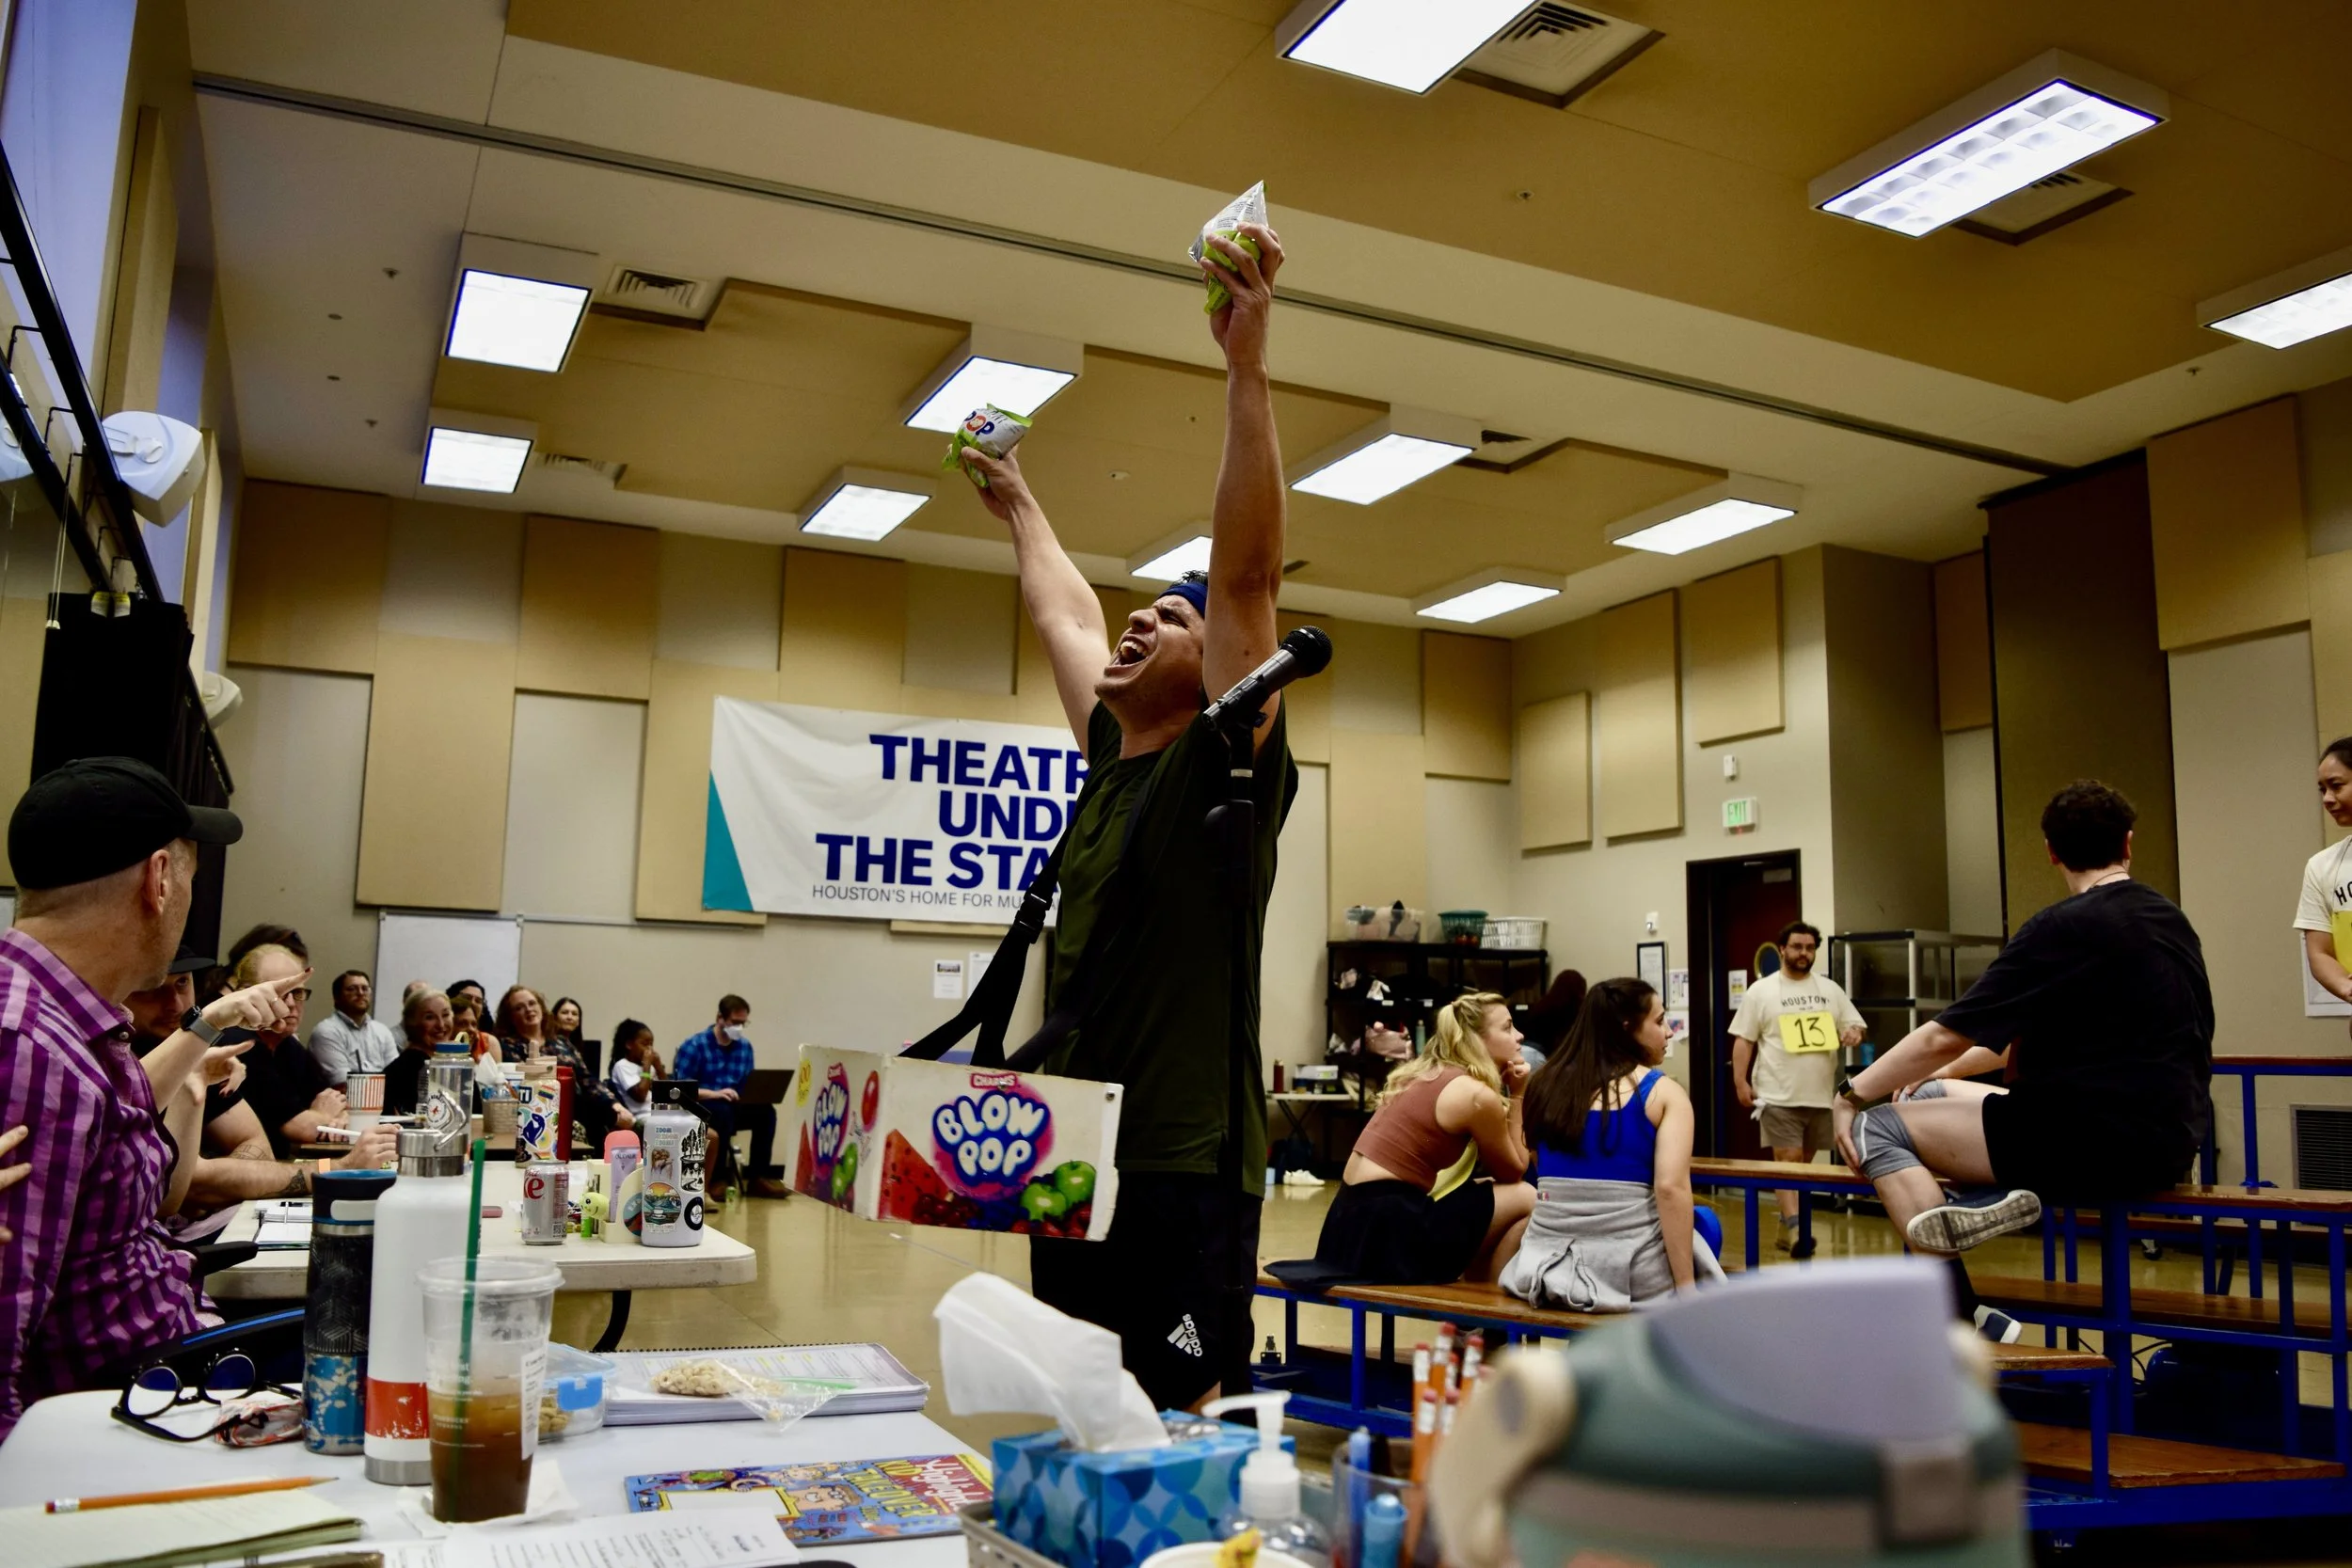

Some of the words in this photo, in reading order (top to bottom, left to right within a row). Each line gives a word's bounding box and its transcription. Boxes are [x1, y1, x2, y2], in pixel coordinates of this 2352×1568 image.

[816, 832, 933, 886] THE
[812, 884, 905, 904] HOUSTON'S
[910, 891, 957, 906] HOME
[962, 893, 993, 908] FOR
[1781, 995, 1827, 1006] HOUSTON
[1794, 1017, 1826, 1048] 13
[936, 1094, 1045, 1145] BLOW
[958, 1137, 1032, 1177] POP
[1183, 1313, 1203, 1356] adidas
[873, 1460, 923, 1476] KID
[843, 1468, 939, 1517] TAKEOVER
